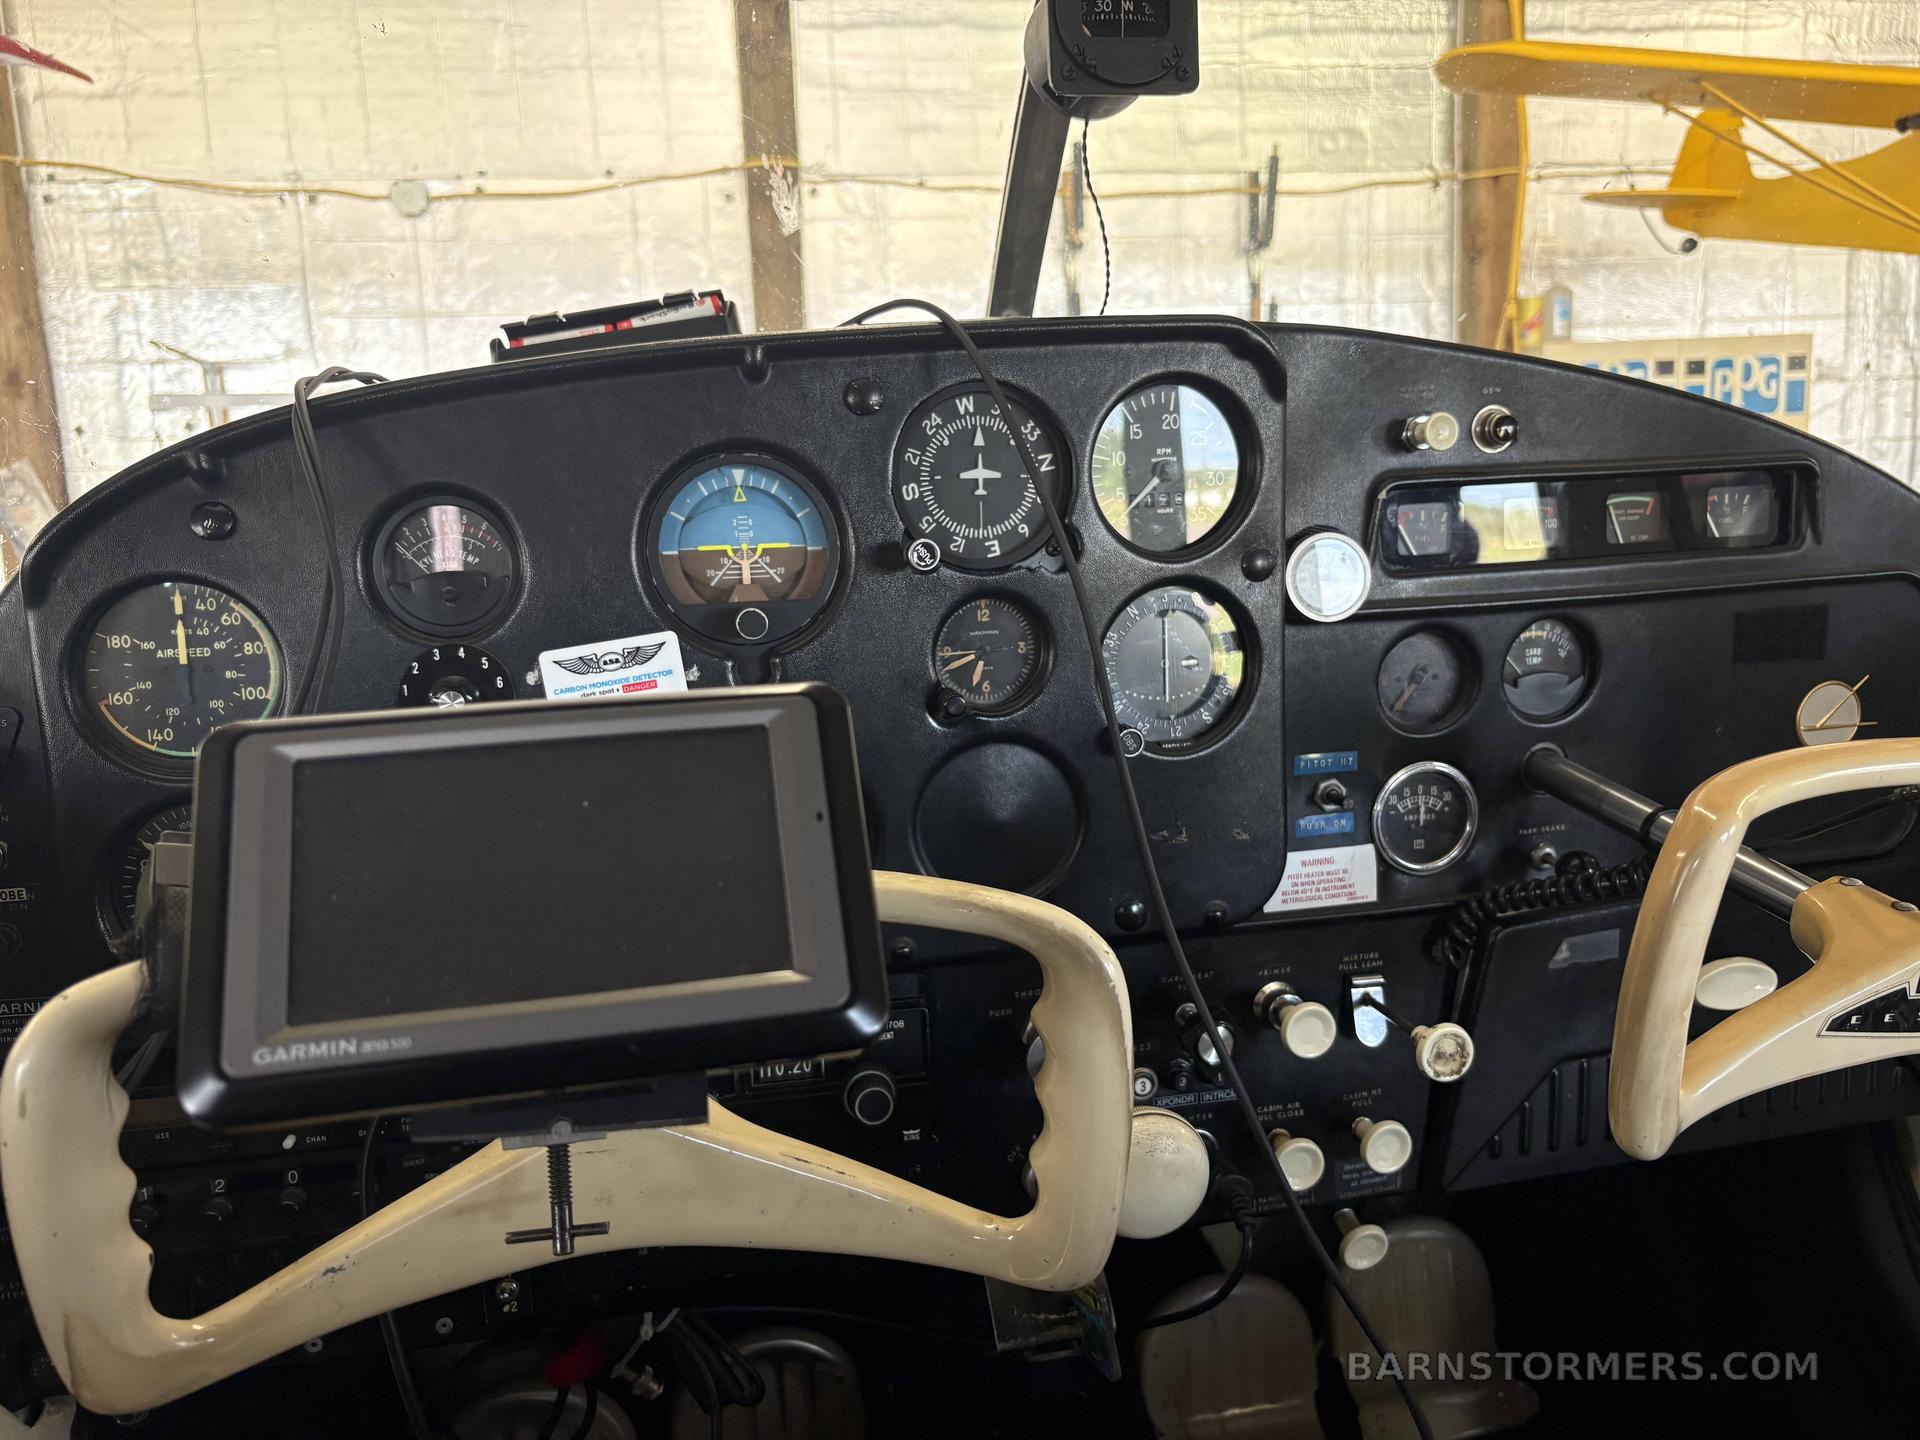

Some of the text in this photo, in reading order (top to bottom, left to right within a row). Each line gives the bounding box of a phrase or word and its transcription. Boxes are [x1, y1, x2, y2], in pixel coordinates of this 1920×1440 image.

[1094, 0, 1112, 12] 30
[955, 396, 975, 415] W
[921, 412, 944, 435] 24
[1162, 414, 1180, 430] 20
[1020, 419, 1042, 441] 33
[1129, 423, 1143, 440] 15
[1190, 430, 1208, 447] 25
[904, 448, 922, 466] 21
[1112, 451, 1127, 466] 10
[1156, 448, 1172, 456] RPM
[1037, 453, 1056, 473] N
[1206, 471, 1225, 486] 30
[902, 483, 920, 501] S
[1116, 488, 1126, 503] 5
[462, 515, 469, 525] 5
[1189, 507, 1207, 522] 35
[421, 518, 428, 527] 3
[482, 521, 489, 531] 6
[919, 516, 937, 534] 15
[1544, 519, 1558, 530] 100
[403, 527, 411, 536] 2
[949, 536, 966, 553] 12
[984, 540, 1001, 558] E
[420, 555, 435, 568] CYL
[458, 550, 481, 566] TEMP
[720, 557, 729, 565] 10
[763, 556, 770, 564] 10
[914, 543, 936, 566] PUSH
[706, 569, 715, 577] 20
[776, 567, 785, 575] 20
[195, 598, 217, 612] 40
[220, 612, 242, 625] 60
[977, 609, 991, 623] 12
[1126, 606, 1140, 620] N
[196, 627, 210, 636] 40
[106, 635, 132, 649] 180
[139, 641, 156, 650] 160
[214, 642, 227, 650] 60
[1103, 632, 1118, 648] 33
[156, 647, 211, 659] AIRSEED
[243, 641, 264, 655] 80
[457, 646, 466, 659] 4
[1017, 641, 1027, 654] 3
[432, 648, 441, 662] 3
[603, 656, 622, 667] ASA
[412, 662, 420, 675] 2
[481, 657, 489, 670] 5
[225, 670, 238, 679] 80
[136, 681, 153, 690] 140
[496, 676, 505, 690] 6
[553, 668, 674, 697] CARBON MONOXIDE DETECTOR
[982, 680, 991, 693] 6
[241, 686, 267, 701] 100
[402, 684, 409, 697] 1
[580, 680, 658, 699] dark spot DANGER
[108, 692, 134, 706] 160
[209, 700, 225, 709] 100
[165, 708, 181, 717] 120
[1201, 713, 1213, 724] S
[147, 727, 174, 742] 140
[1136, 721, 1150, 736] 24
[1169, 726, 1182, 739] 21
[1123, 733, 1137, 751] OBS
[1299, 756, 1354, 769] PITOT HT
[1403, 787, 1411, 797] 15
[1417, 785, 1423, 794] 0
[1430, 785, 1438, 795] 15
[1443, 791, 1452, 801] 30
[1388, 795, 1398, 805] 30
[1300, 819, 1346, 831] PUSH ON
[1541, 824, 1566, 833] BRAKE
[1300, 856, 1335, 868] WARNING
[1287, 867, 1349, 881] PITOT HEATER MUST BE
[1300, 880, 1315, 888] WHEN
[1316, 876, 1346, 886] OPERATING
[1281, 889, 1299, 898] BELOW
[1321, 882, 1356, 893] INSTRUMENT
[1281, 894, 1323, 905] METEROLOGICAL
[1324, 890, 1357, 901] CONDITIONS
[1342, 951, 1379, 962] MIXTURE
[1338, 959, 1384, 971] PULL LEAN
[989, 1008, 1012, 1018] PUSH
[253, 1037, 358, 1066] GARMIN
[1139, 1081, 1147, 1092] 3
[1180, 1076, 1187, 1087] 3
[1343, 1091, 1369, 1101] CABIN
[1256, 1101, 1301, 1114] CABIN AIR
[1352, 1099, 1373, 1108] PULL
[1277, 1109, 1305, 1120] CLOSE
[155, 1131, 171, 1141] USE
[305, 1135, 328, 1145] CHAN
[288, 1170, 299, 1184] 0
[214, 1180, 226, 1193] 2
[140, 1187, 149, 1200] 1
[510, 1301, 519, 1313] 2
